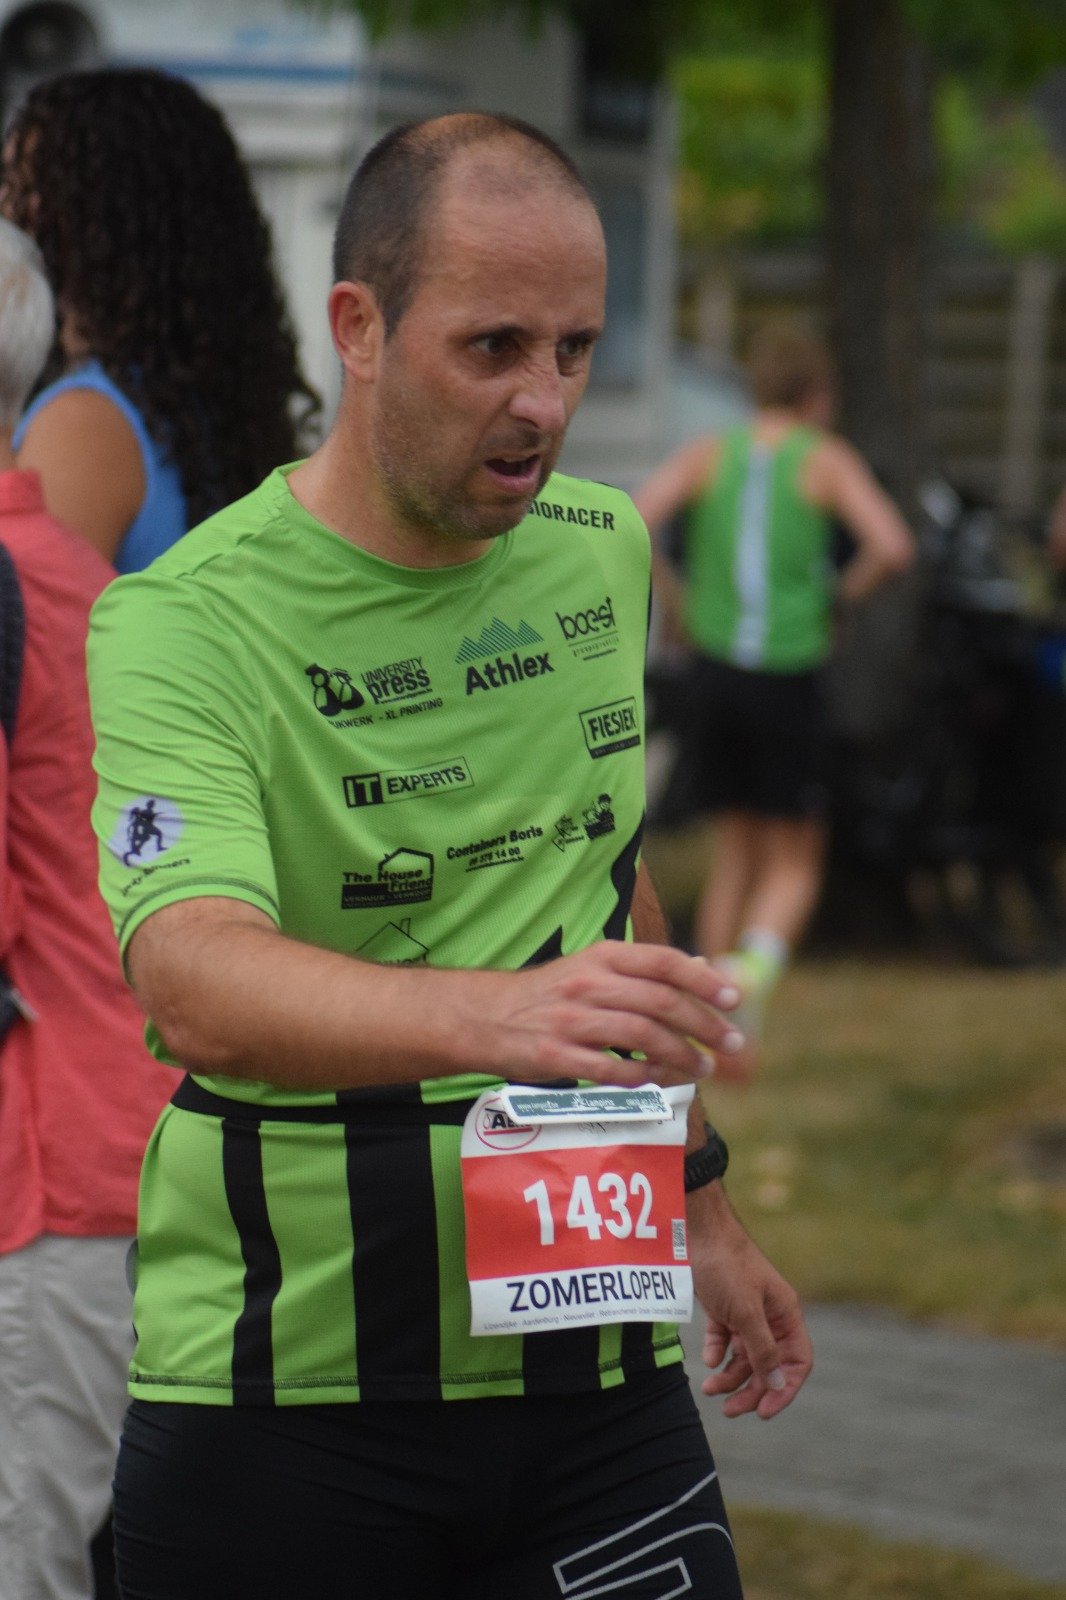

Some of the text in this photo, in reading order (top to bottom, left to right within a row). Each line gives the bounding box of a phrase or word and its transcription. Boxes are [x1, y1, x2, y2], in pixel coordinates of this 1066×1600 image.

[527, 499, 615, 531] IORACER
[361, 656, 423, 684] UNIVERSITY
[366, 669, 431, 705] press
[466, 652, 555, 696] Athlex
[385, 710, 398, 721] XL
[400, 698, 444, 718] PRINTING
[346, 765, 467, 806] IT EXPERTS
[509, 825, 544, 843] Boris
[343, 869, 423, 882] The House
[522, 1172, 658, 1246] 1432
[506, 1270, 677, 1313] ZOMERLOPEN
